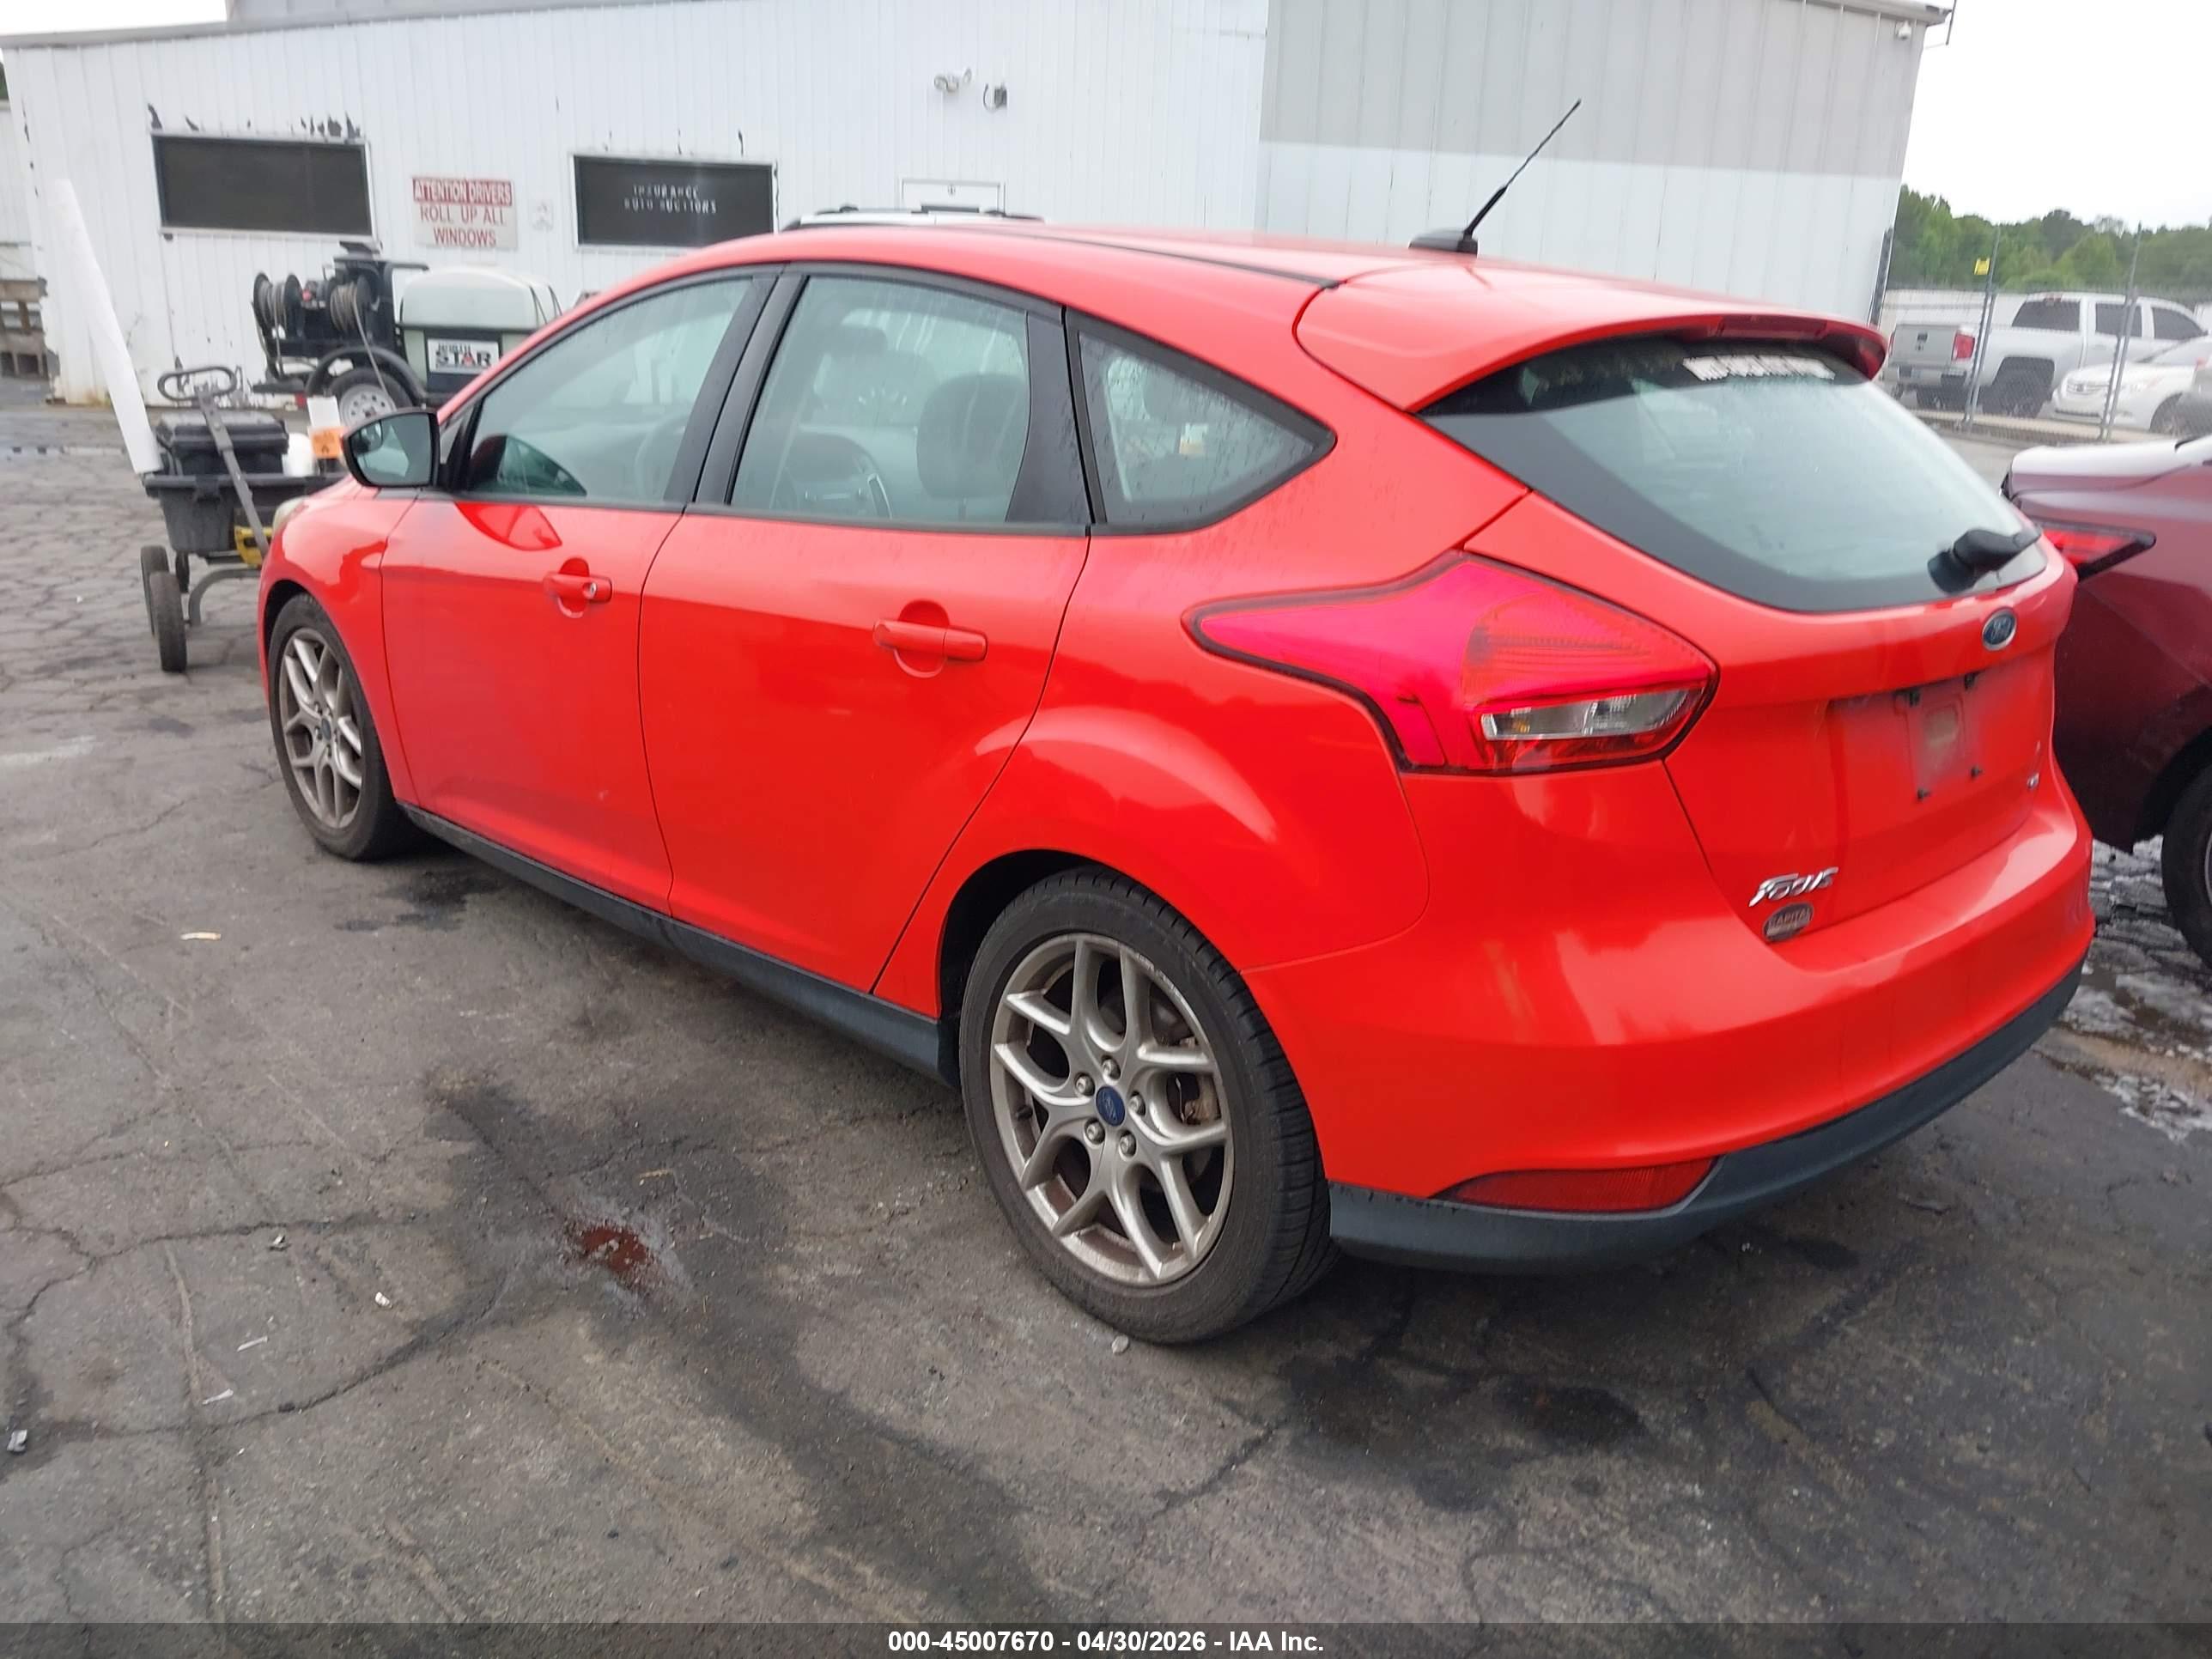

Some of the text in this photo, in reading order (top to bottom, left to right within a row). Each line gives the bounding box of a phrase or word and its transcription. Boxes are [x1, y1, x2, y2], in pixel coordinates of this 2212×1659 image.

[414, 179, 511, 206] ATTENTION DRIVERS
[420, 204, 505, 225] ROLL UP ALL
[434, 228, 496, 247] WINDOWS
[435, 349, 492, 368] STAR
